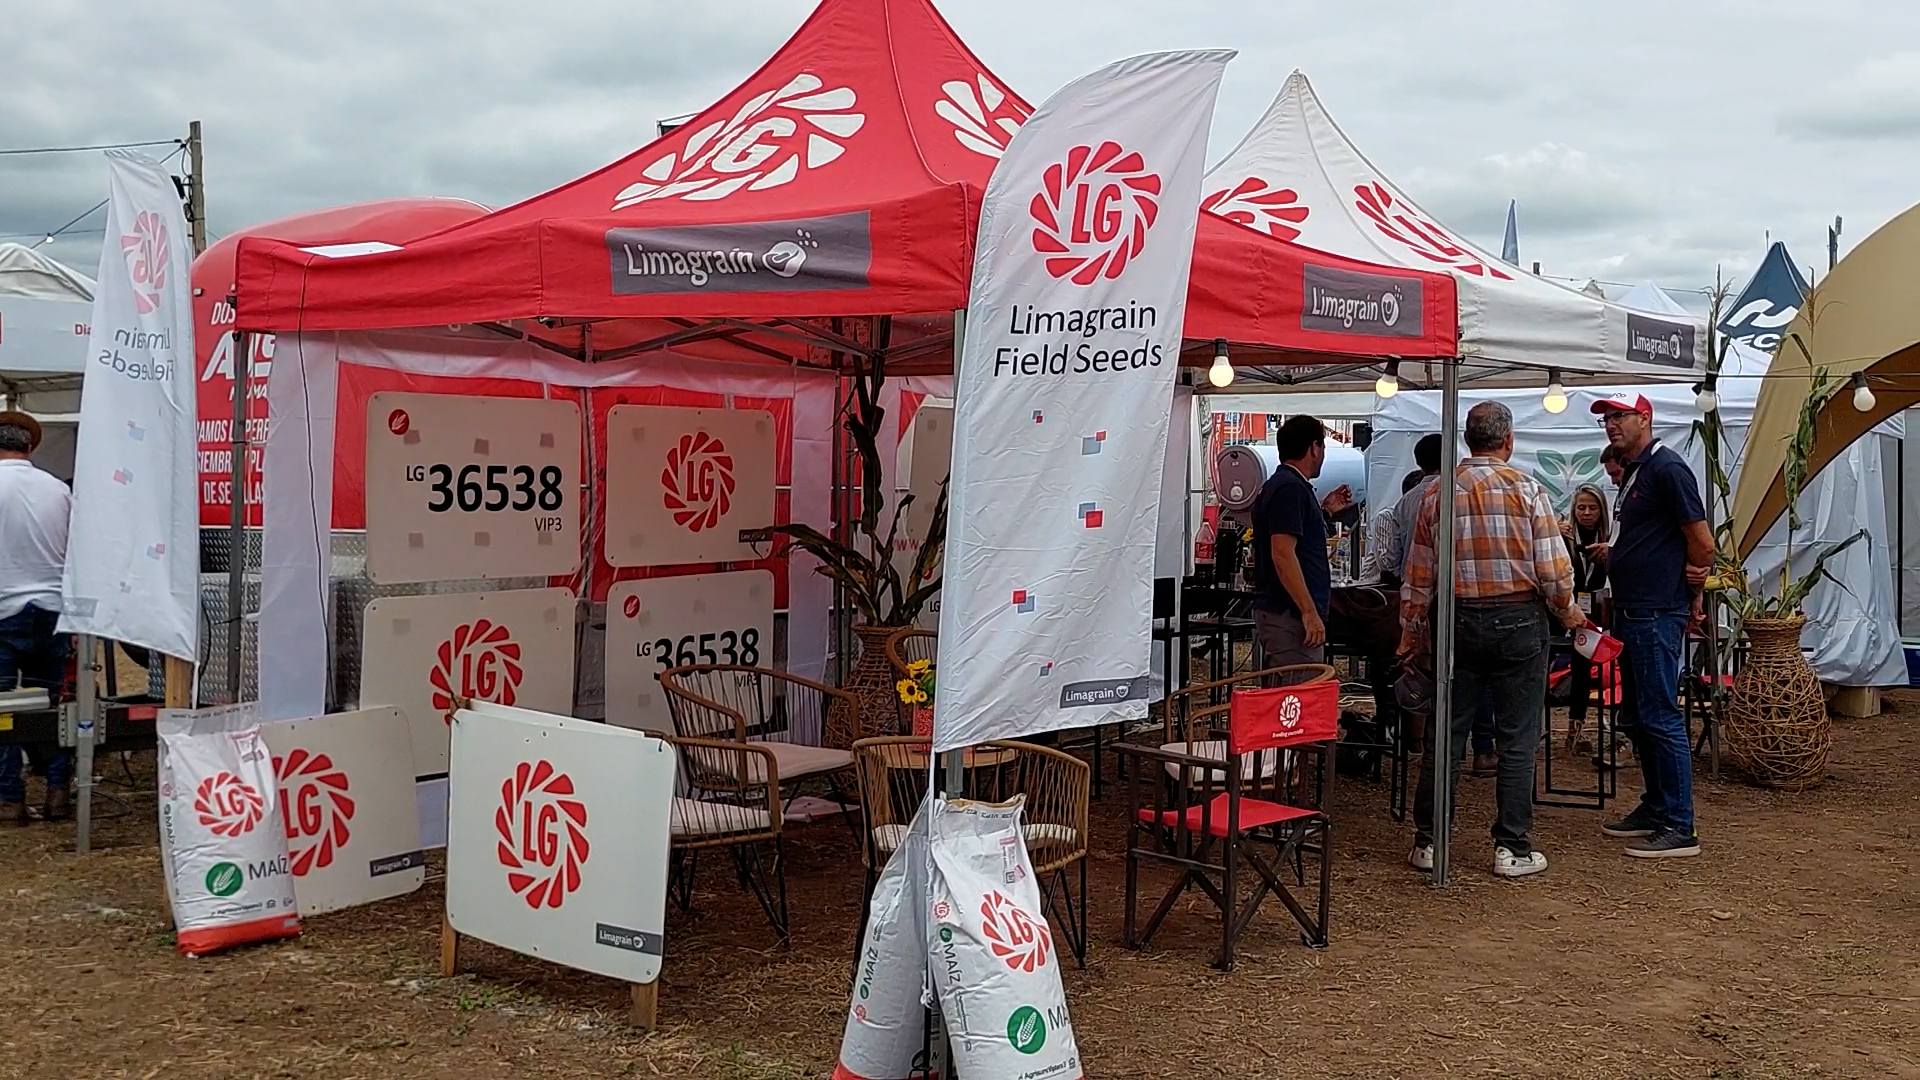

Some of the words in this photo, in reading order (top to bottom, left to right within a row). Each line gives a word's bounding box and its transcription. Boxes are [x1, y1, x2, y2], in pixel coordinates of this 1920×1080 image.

[1070, 183, 1122, 243] LG
[623, 243, 757, 287] Limagrain
[1010, 300, 1156, 338] Limagrain
[1311, 286, 1379, 329] Limagrain
[994, 343, 1069, 377] Field
[1073, 339, 1162, 374] Seeds
[1632, 329, 1670, 360] Limagrain
[406, 465, 425, 482] LG
[428, 463, 563, 512] 36538
[686, 459, 715, 503] LG
[534, 517, 563, 532] VIP3
[636, 641, 651, 658] LG
[653, 627, 760, 681] 36538
[461, 650, 497, 699] LG
[1065, 688, 1115, 703] Limagrain
[1286, 704, 1296, 719] LG
[215, 789, 245, 817] LG
[278, 783, 322, 839] LG
[522, 800, 559, 867] LG
[248, 853, 289, 880] MAÍZ
[600, 930, 633, 946] Limagrain
[1000, 909, 1034, 946] LG
[943, 943, 963, 985] MAÍZ
